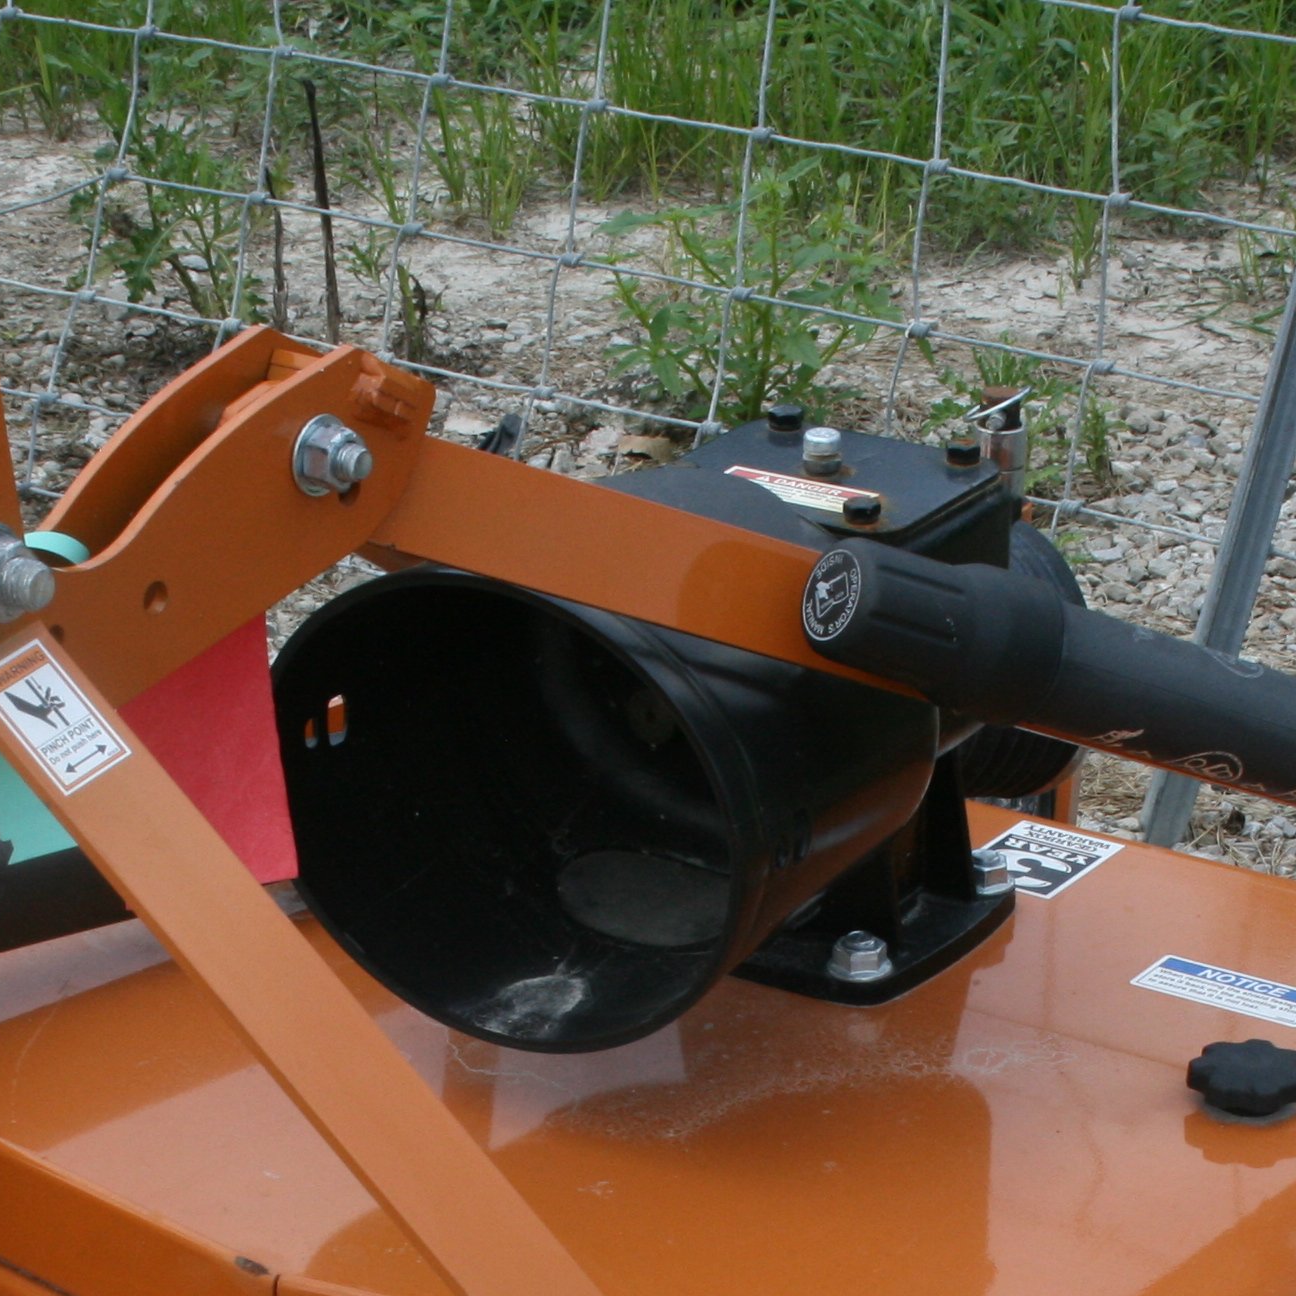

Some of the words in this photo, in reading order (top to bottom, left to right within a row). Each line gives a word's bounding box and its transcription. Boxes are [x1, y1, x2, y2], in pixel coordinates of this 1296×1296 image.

[773, 478, 843, 496] DANGER
[814, 554, 844, 580] INSIDE
[805, 598, 825, 635] MANUAL
[39, 733, 70, 757] PINCH
[65, 717, 95, 740] POINT
[48, 753, 62, 765] Do
[57, 746, 73, 759] not
[68, 736, 90, 753] push
[84, 727, 102, 741] here
[1024, 825, 1111, 850] WARRANTY
[1025, 831, 1098, 852] GEARBOX
[1004, 838, 1087, 865] YEAR
[1195, 968, 1290, 998] NOTICE
